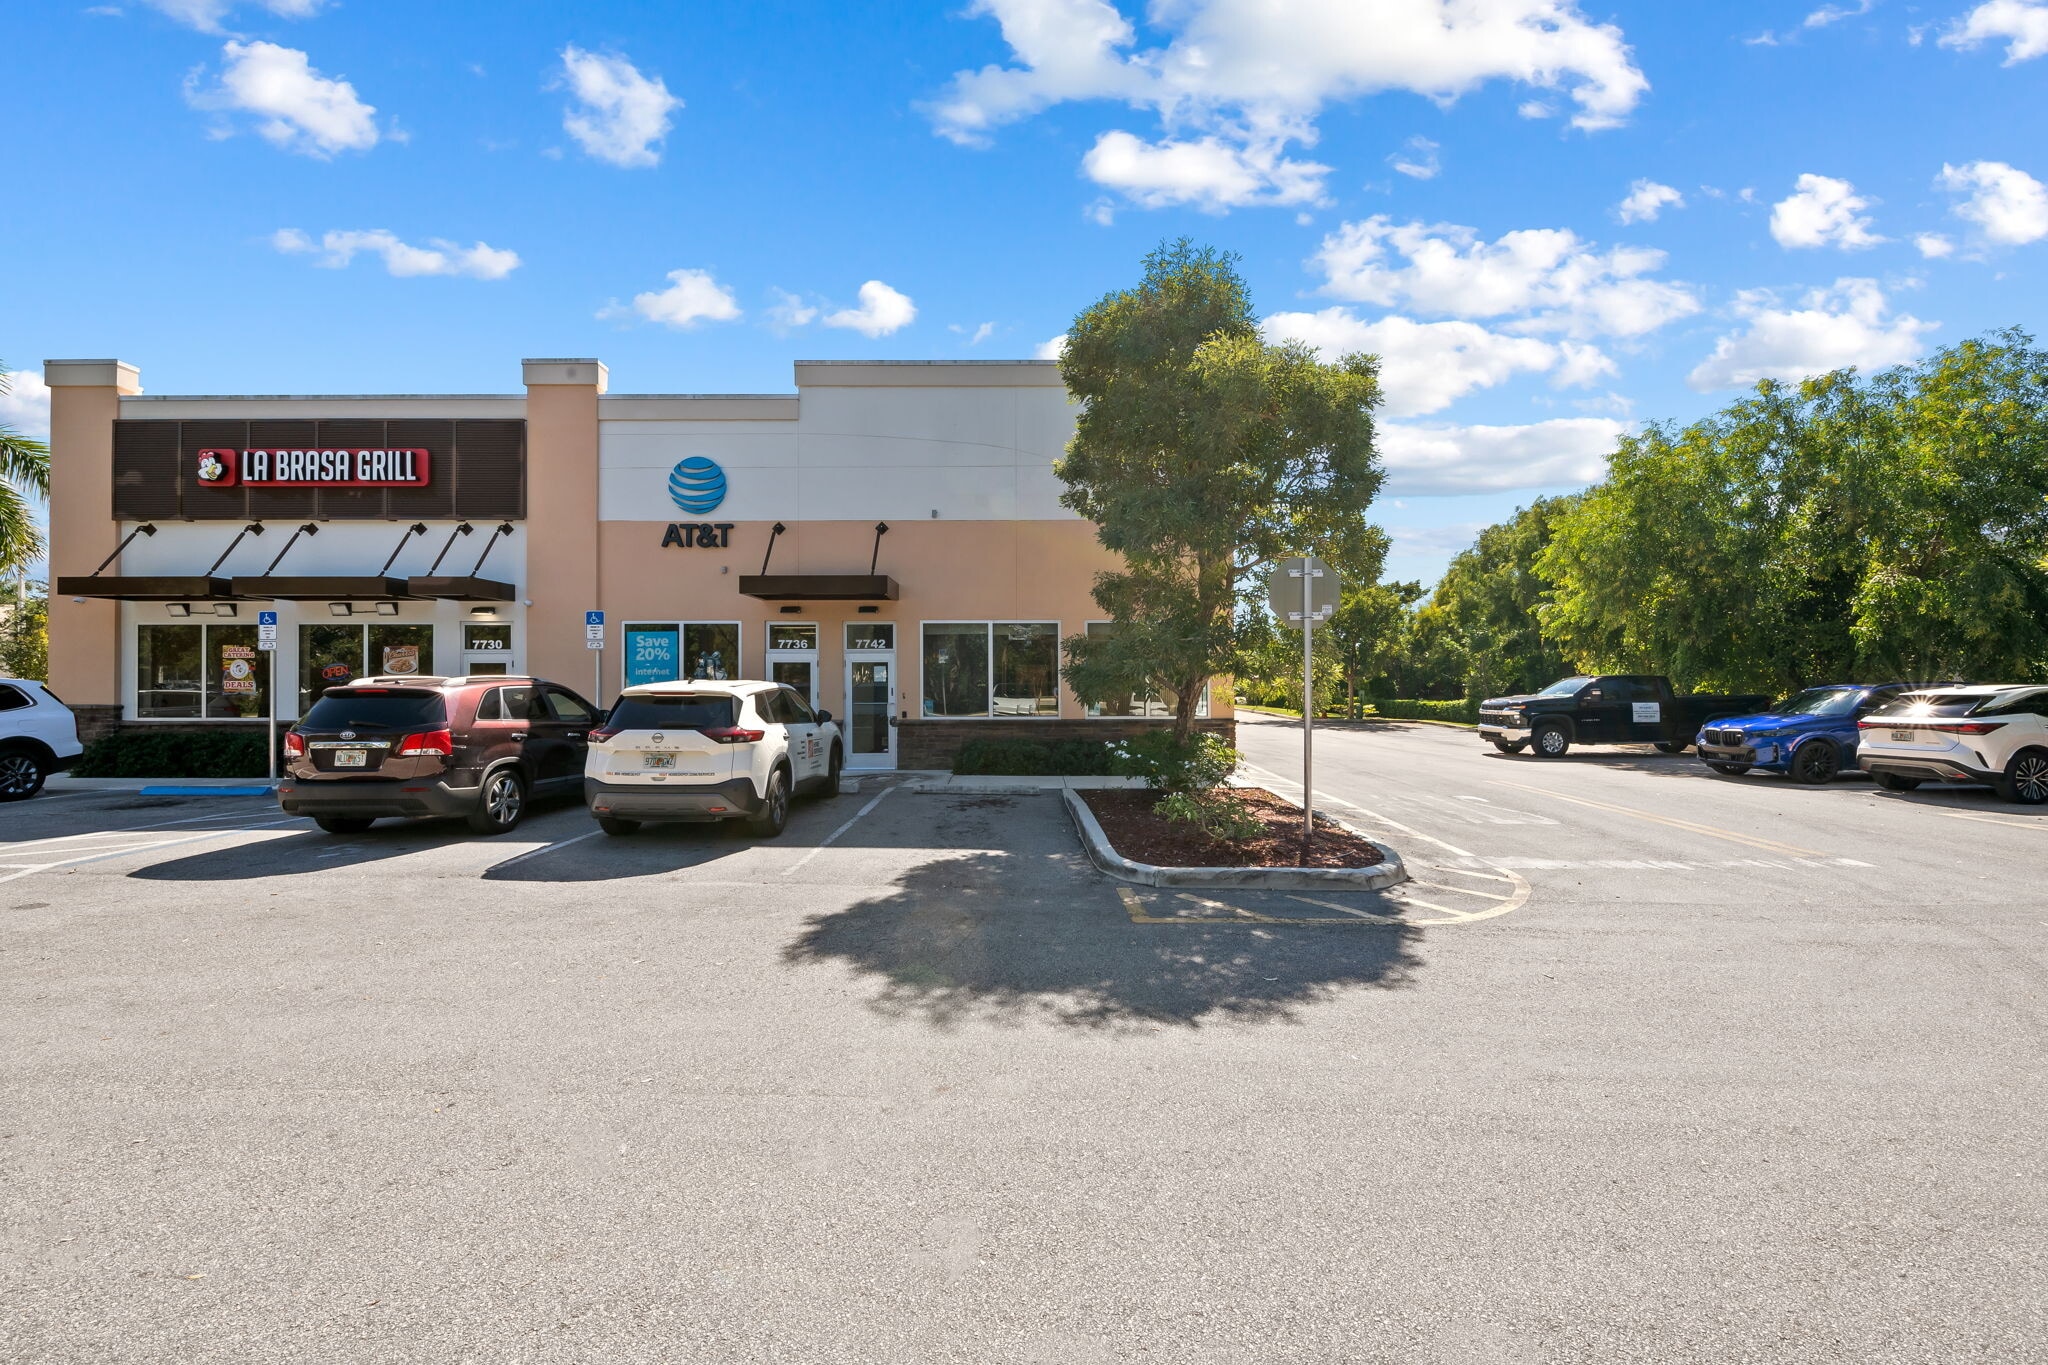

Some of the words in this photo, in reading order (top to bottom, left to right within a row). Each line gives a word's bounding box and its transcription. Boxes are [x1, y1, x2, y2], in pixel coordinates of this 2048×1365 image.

[243, 451, 268, 481] LA
[275, 451, 350, 481] BRASA
[357, 451, 417, 481] GRILL
[661, 523, 734, 548] AT&T
[472, 639, 503, 649] 7730
[636, 635, 669, 647] Save
[778, 639, 808, 648] 7736
[856, 639, 886, 648] 7742
[635, 647, 671, 661] 20%
[322, 665, 349, 679] OPEN
